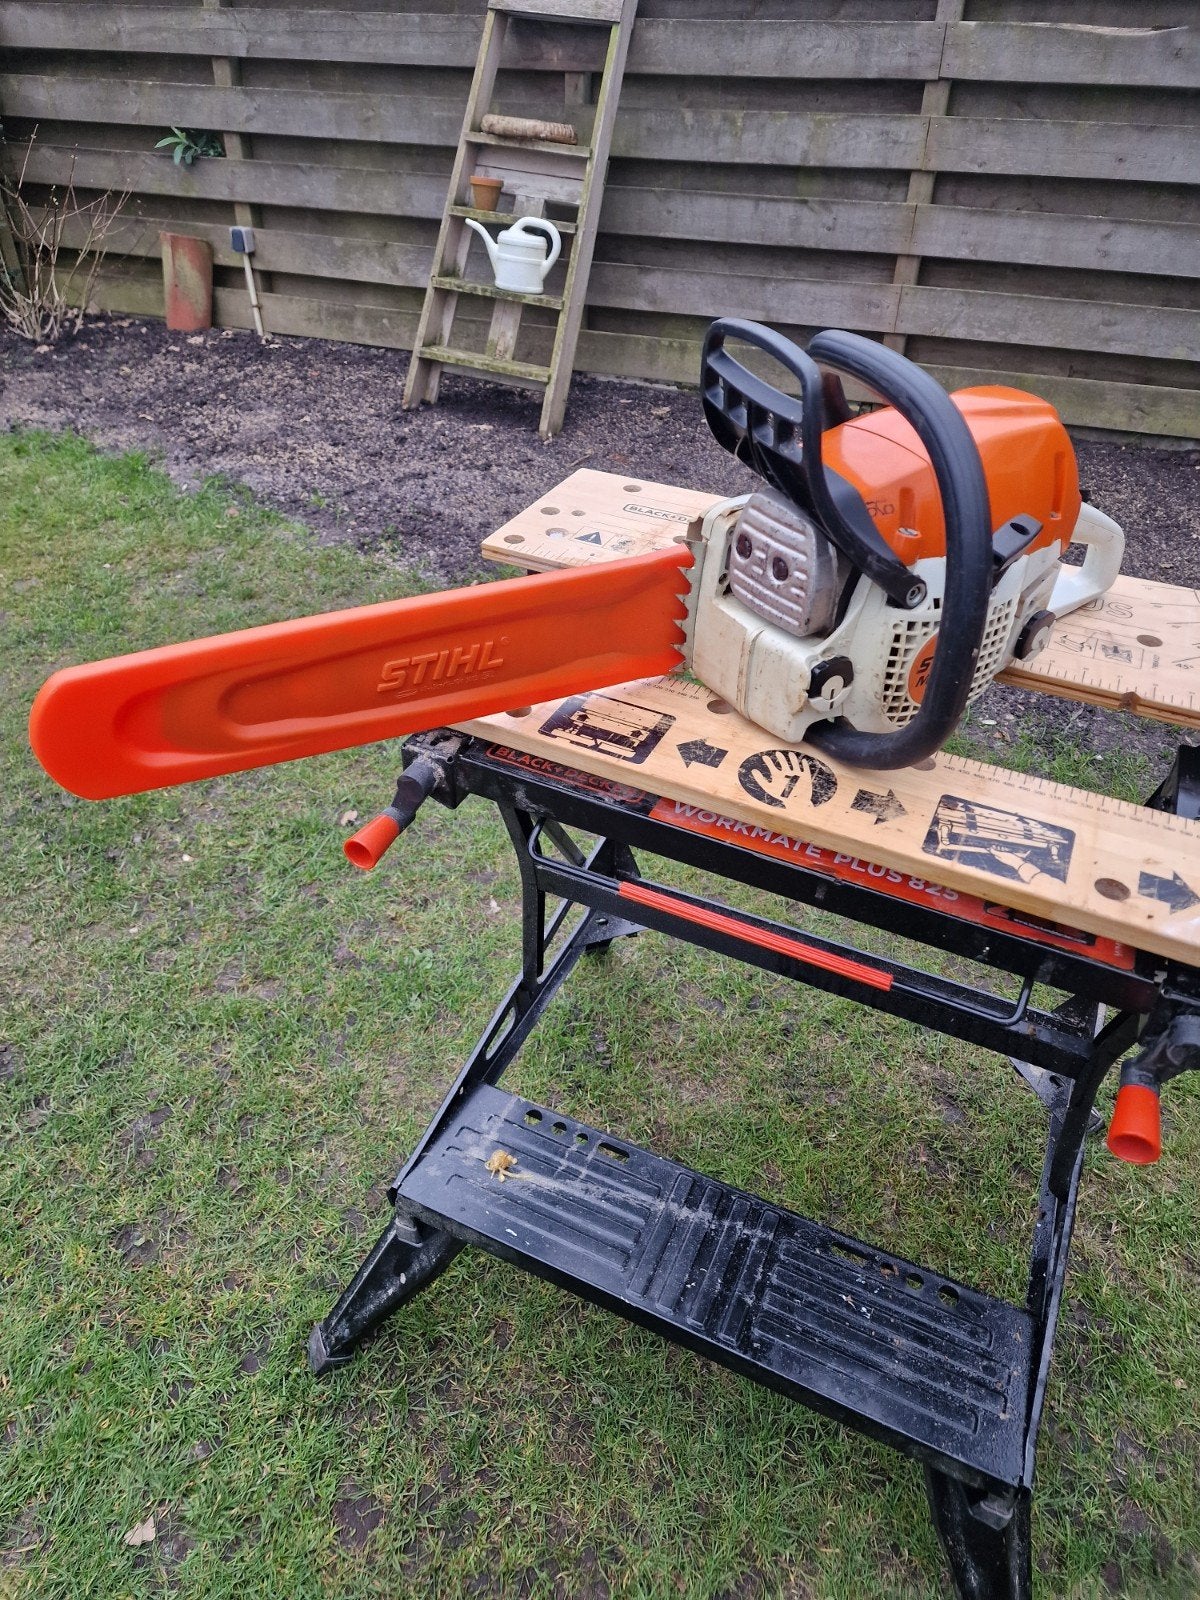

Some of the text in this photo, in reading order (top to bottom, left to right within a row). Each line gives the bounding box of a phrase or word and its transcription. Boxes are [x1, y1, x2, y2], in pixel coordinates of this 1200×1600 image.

[629, 505, 687, 522] BLACK+D
[377, 641, 504, 692] STIHL
[674, 801, 959, 901] WORKMATE PLUS 825
